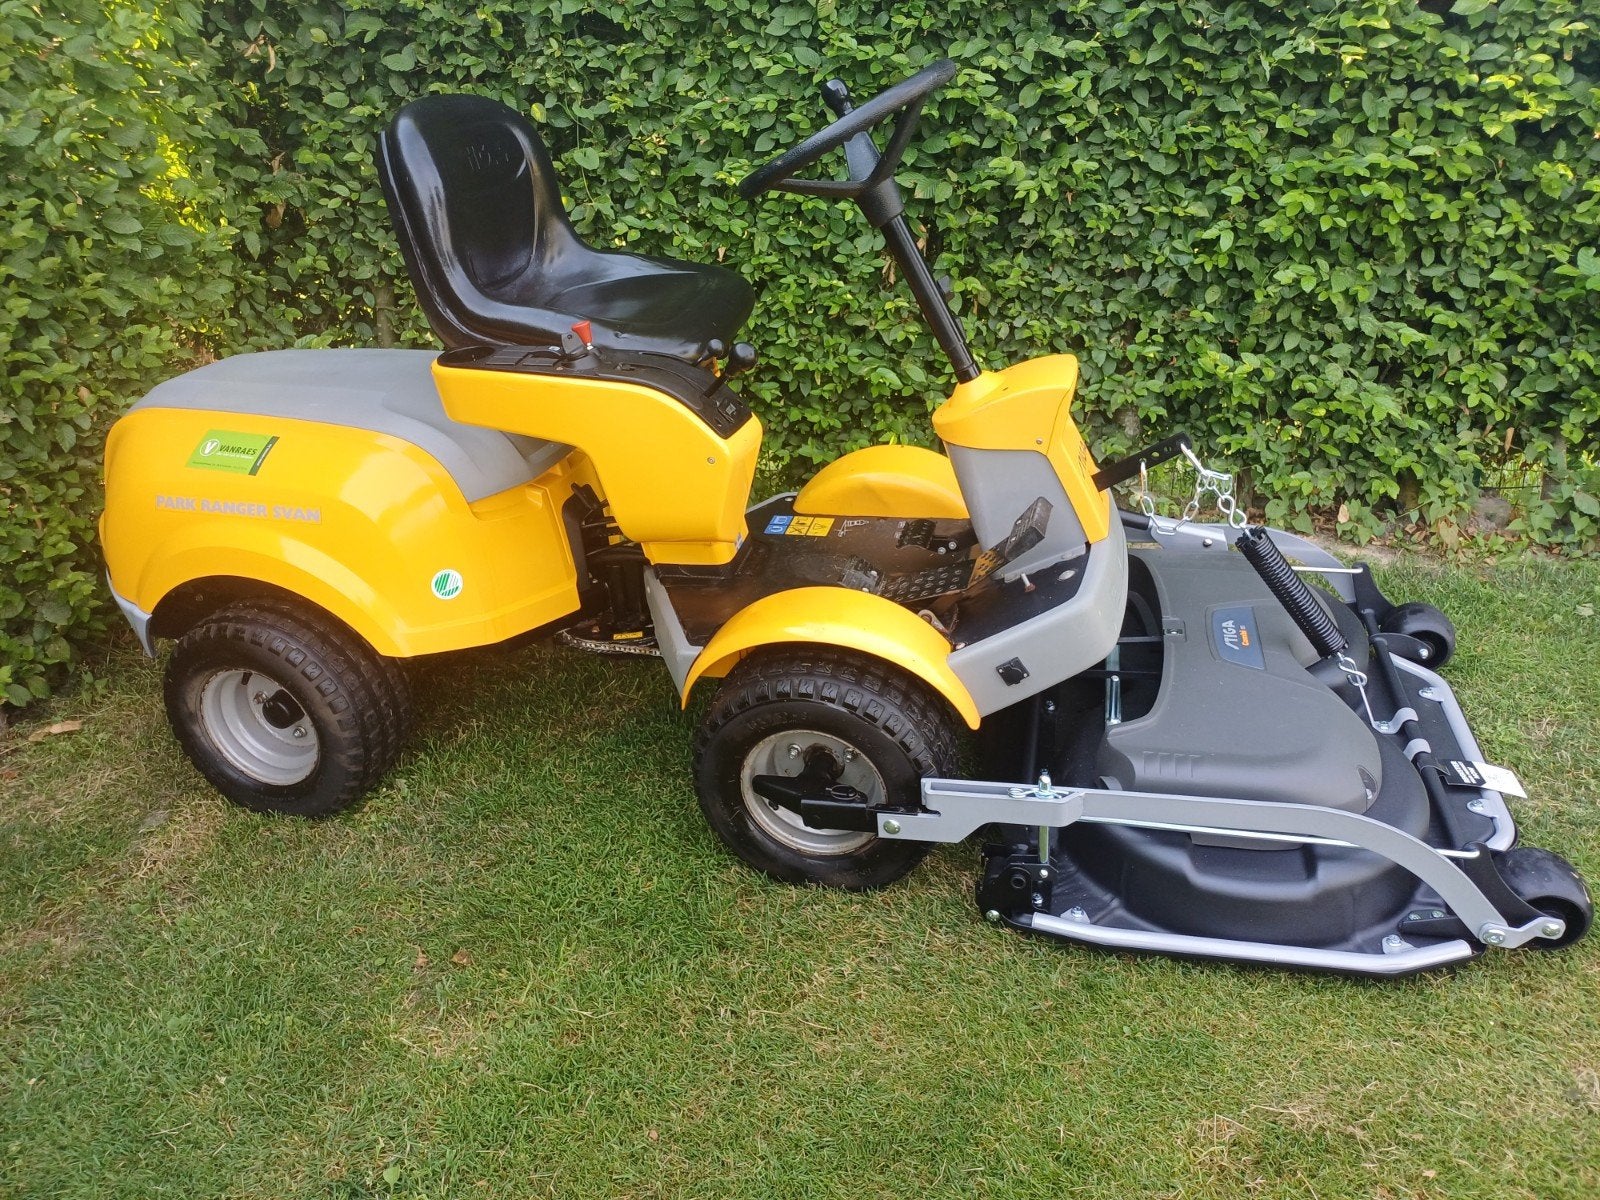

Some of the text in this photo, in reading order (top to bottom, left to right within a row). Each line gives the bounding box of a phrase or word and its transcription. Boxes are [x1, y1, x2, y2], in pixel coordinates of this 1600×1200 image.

[219, 444, 258, 456] VANRAES
[156, 495, 321, 522] PARK RANGER SVAN
[1222, 620, 1240, 650] STIGA
